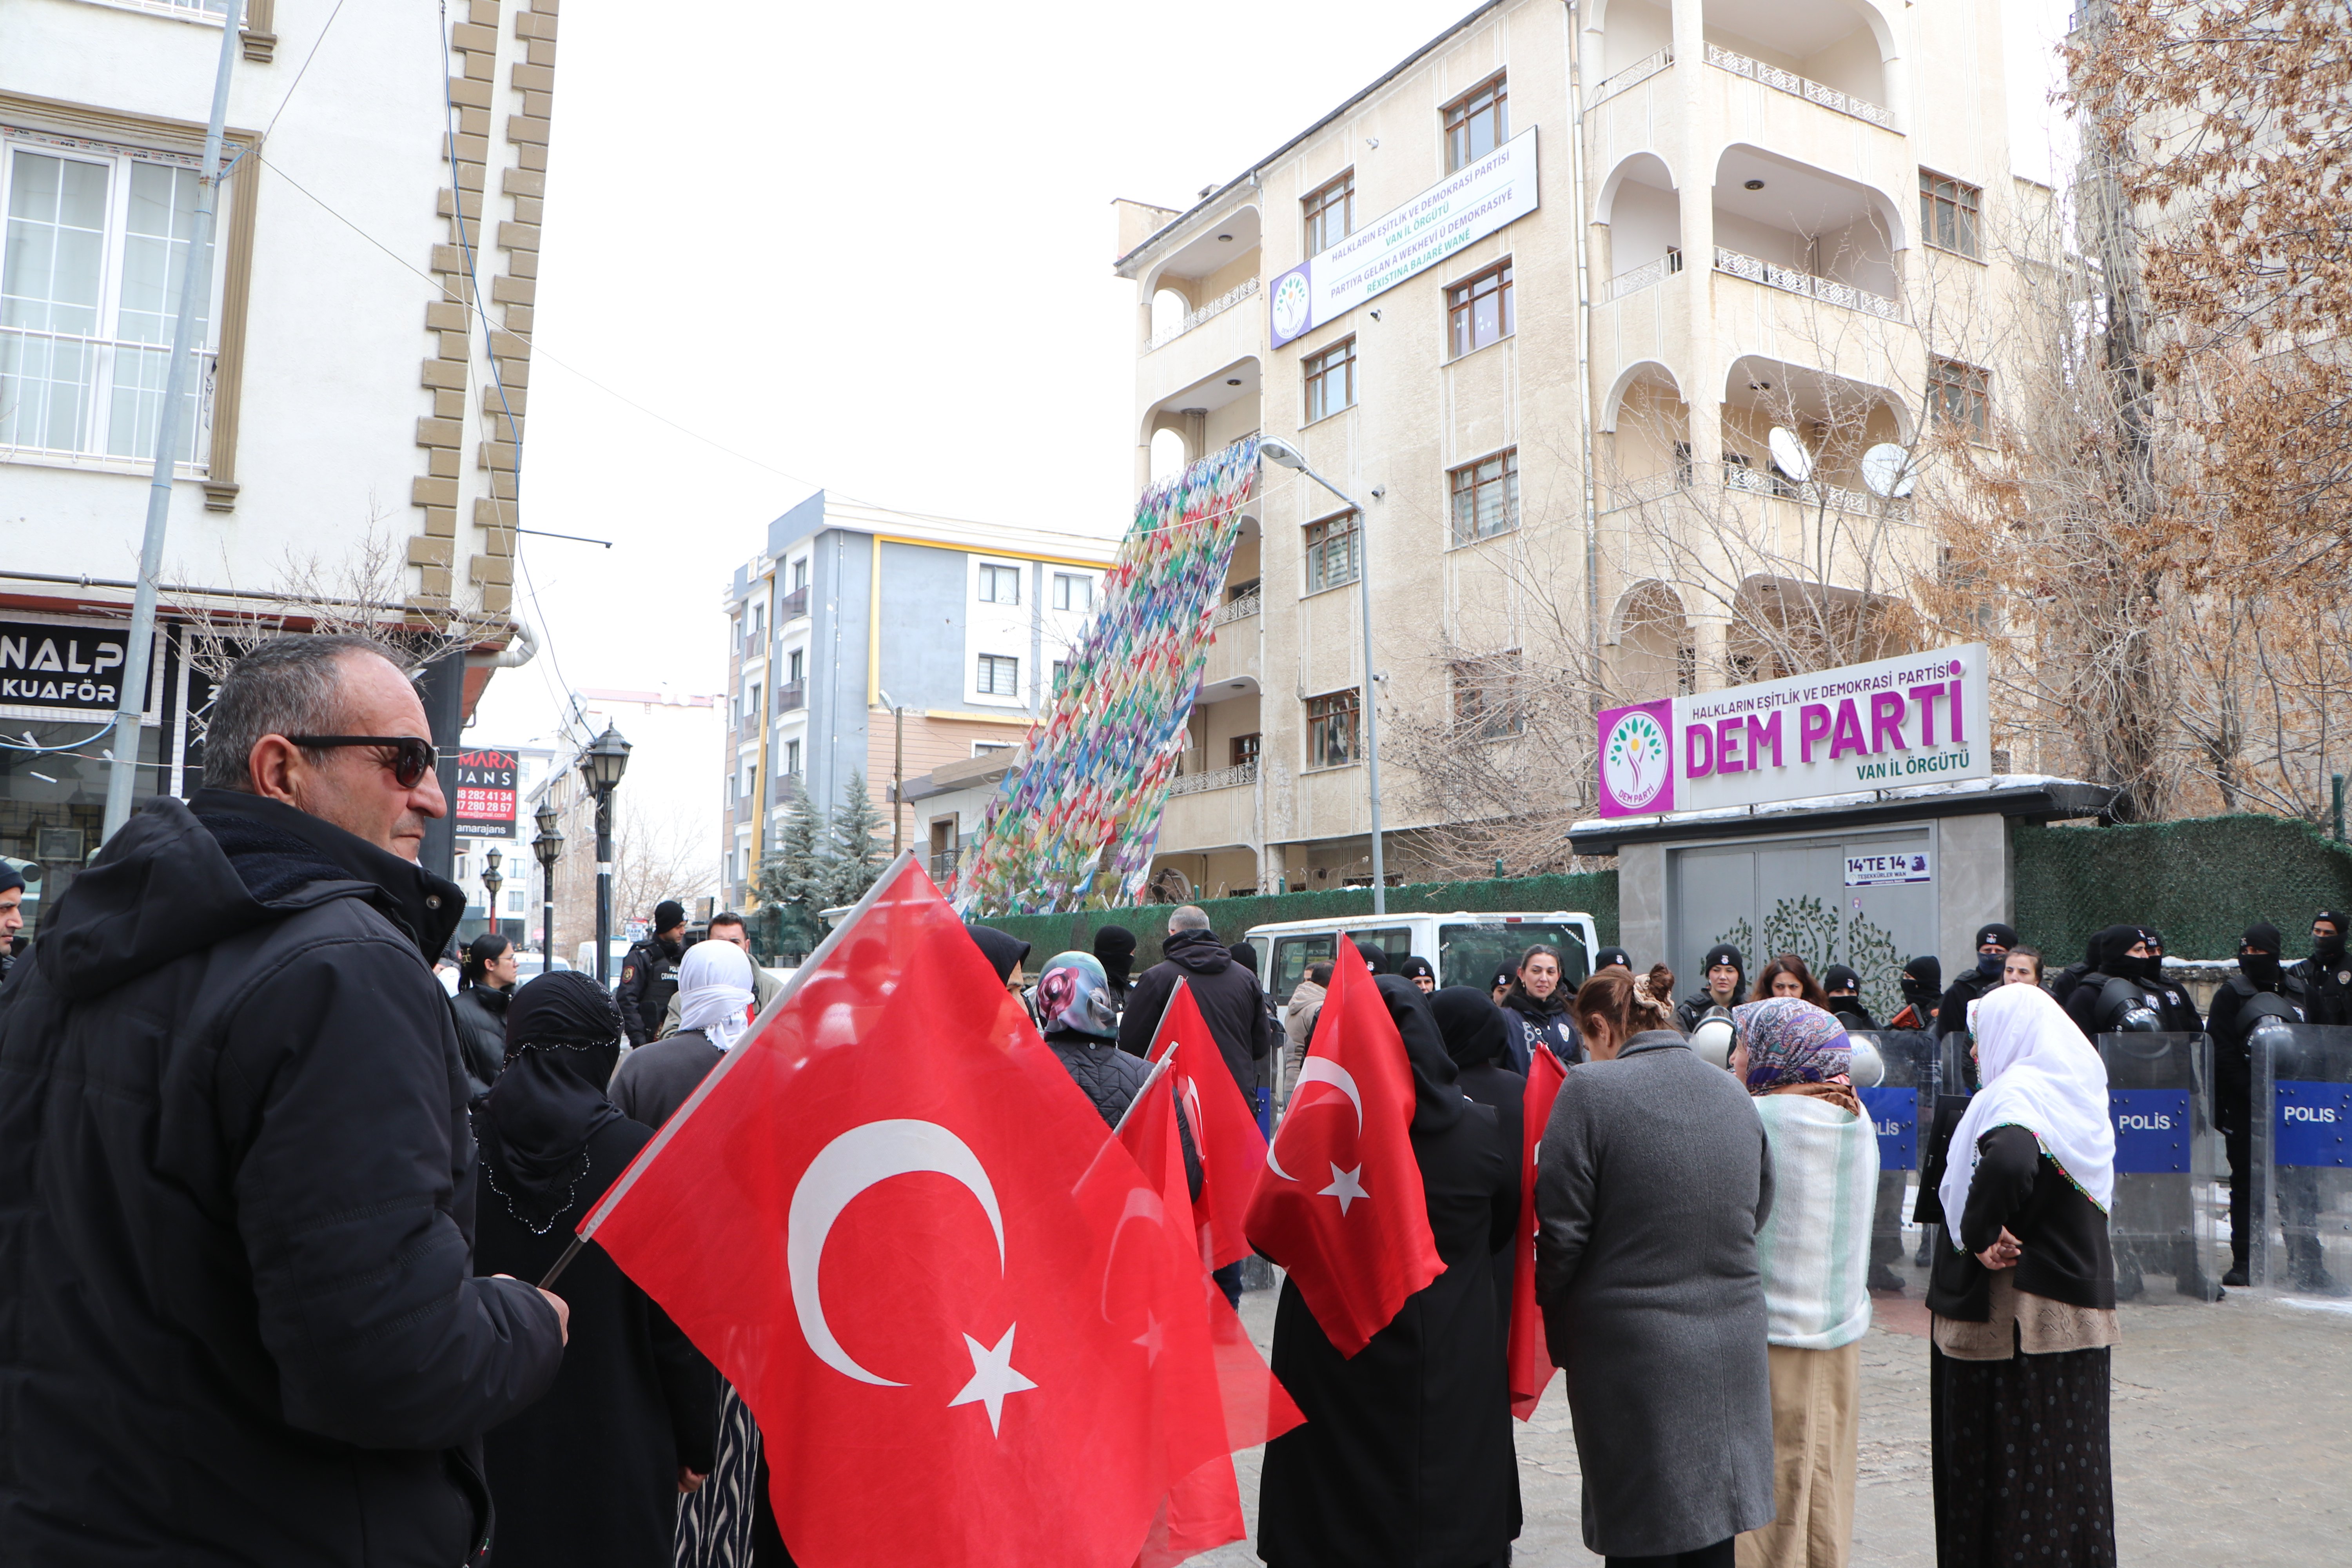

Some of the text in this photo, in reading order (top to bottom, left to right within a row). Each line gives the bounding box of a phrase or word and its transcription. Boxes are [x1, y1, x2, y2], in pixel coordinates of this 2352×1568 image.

[1332, 149, 1509, 263] HALKLARIN EŞİTLİK VE DEMOKRASİ PARTİSİ
[1386, 200, 1449, 247] VAN İL ÖRGÜTÜ
[1331, 187, 1513, 299] PARTIYA GELAN A WEKHEVÎ Û DEMOKRASIYÊ
[1367, 227, 1470, 294] RÊXISTINA BAJARÊ WANÊ
[2, 678, 116, 702] KUAFÖR
[1693, 661, 1949, 720] HALKLARIN EŞİTLİK VE DEMOKRASİ PARTİSİ
[1686, 659, 1964, 779] DEM PARTİ
[1857, 749, 1969, 780] VAN İL ÖRGÜTÜ
[467, 801, 485, 811] 280
[487, 802, 498, 811] 28
[500, 803, 512, 812] 57
[468, 790, 485, 800] 282
[487, 791, 498, 801] 41
[500, 792, 512, 802] 34
[1618, 789, 1633, 803] DEM
[1847, 855, 1906, 873] 14'TE 14
[1858, 871, 1893, 880] TEŞEKKÜRLER
[2119, 1112, 2171, 1130] POLİS
[2284, 1106, 2335, 1123] POLIS
[1872, 1118, 1900, 1136] LİS
